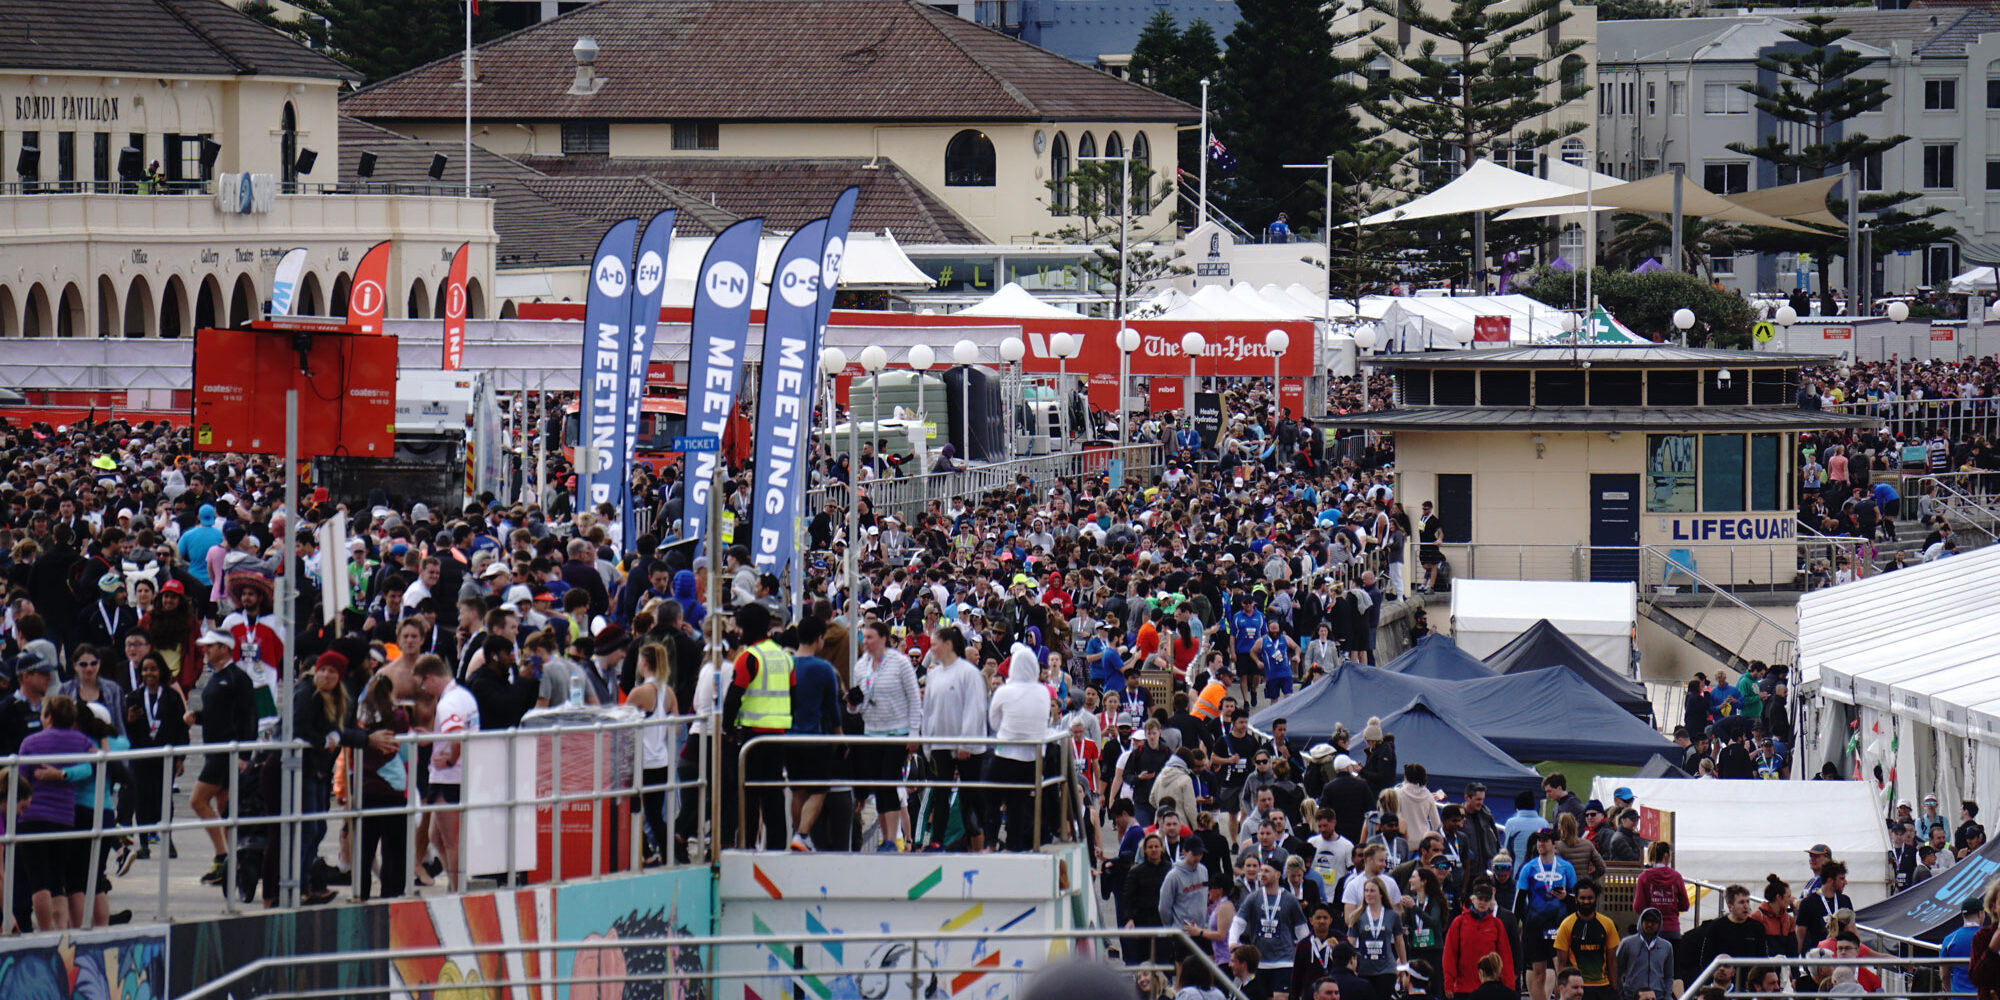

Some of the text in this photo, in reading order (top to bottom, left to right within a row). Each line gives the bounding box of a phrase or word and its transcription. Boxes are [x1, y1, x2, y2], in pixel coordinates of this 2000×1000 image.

[16, 96, 119, 121] BONDI PAVILION
[132, 249, 148, 264] Office
[201, 248, 220, 268] Gallery
[235, 248, 254, 263] Theatre
[826, 253, 841, 272] T-Z
[599, 269, 625, 286] A-D
[639, 265, 660, 282] E-H
[711, 273, 745, 295] I-N
[783, 271, 819, 293] O-S
[1144, 335, 1181, 358] The
[592, 323, 620, 472] MEETING
[693, 336, 736, 506] MEETNG
[765, 336, 807, 515] MEETING
[675, 439, 715, 449] P TICKET
[1673, 518, 1795, 541] LIFEGUARD
